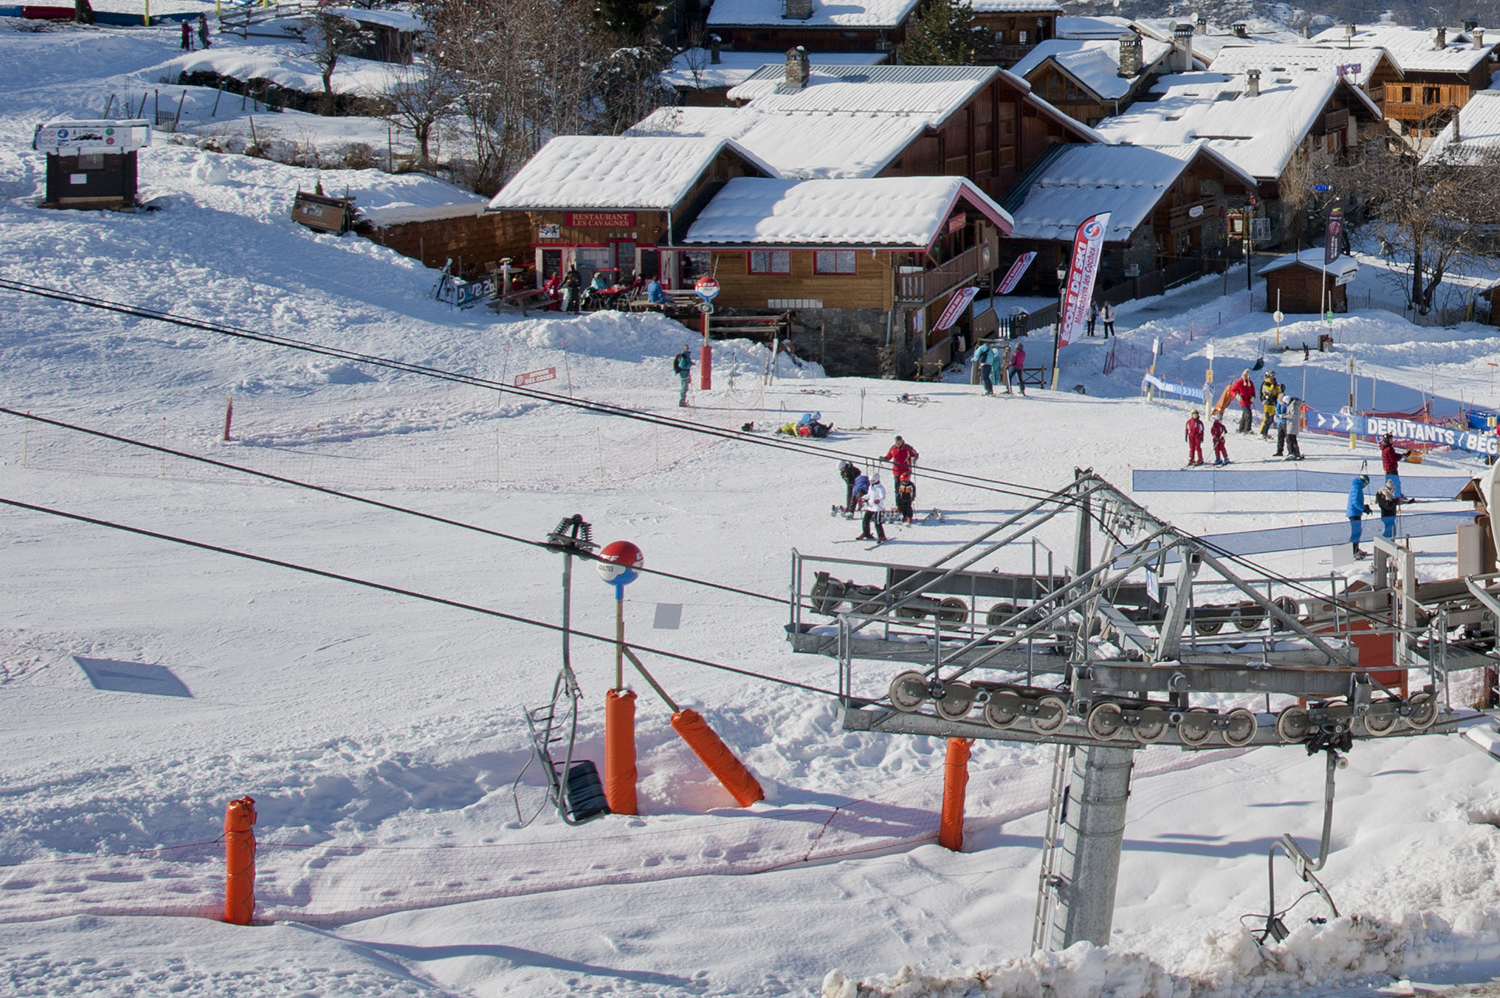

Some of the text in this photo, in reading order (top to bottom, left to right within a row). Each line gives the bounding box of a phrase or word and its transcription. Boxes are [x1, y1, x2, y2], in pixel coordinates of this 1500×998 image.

[1074, 241, 1088, 271] SKI
[1084, 247, 1096, 272] Coches
[1070, 271, 1082, 292] DE
[1083, 274, 1091, 285] les
[1074, 285, 1089, 325] Montchavin
[1367, 417, 1454, 445] DEBUTANTS
